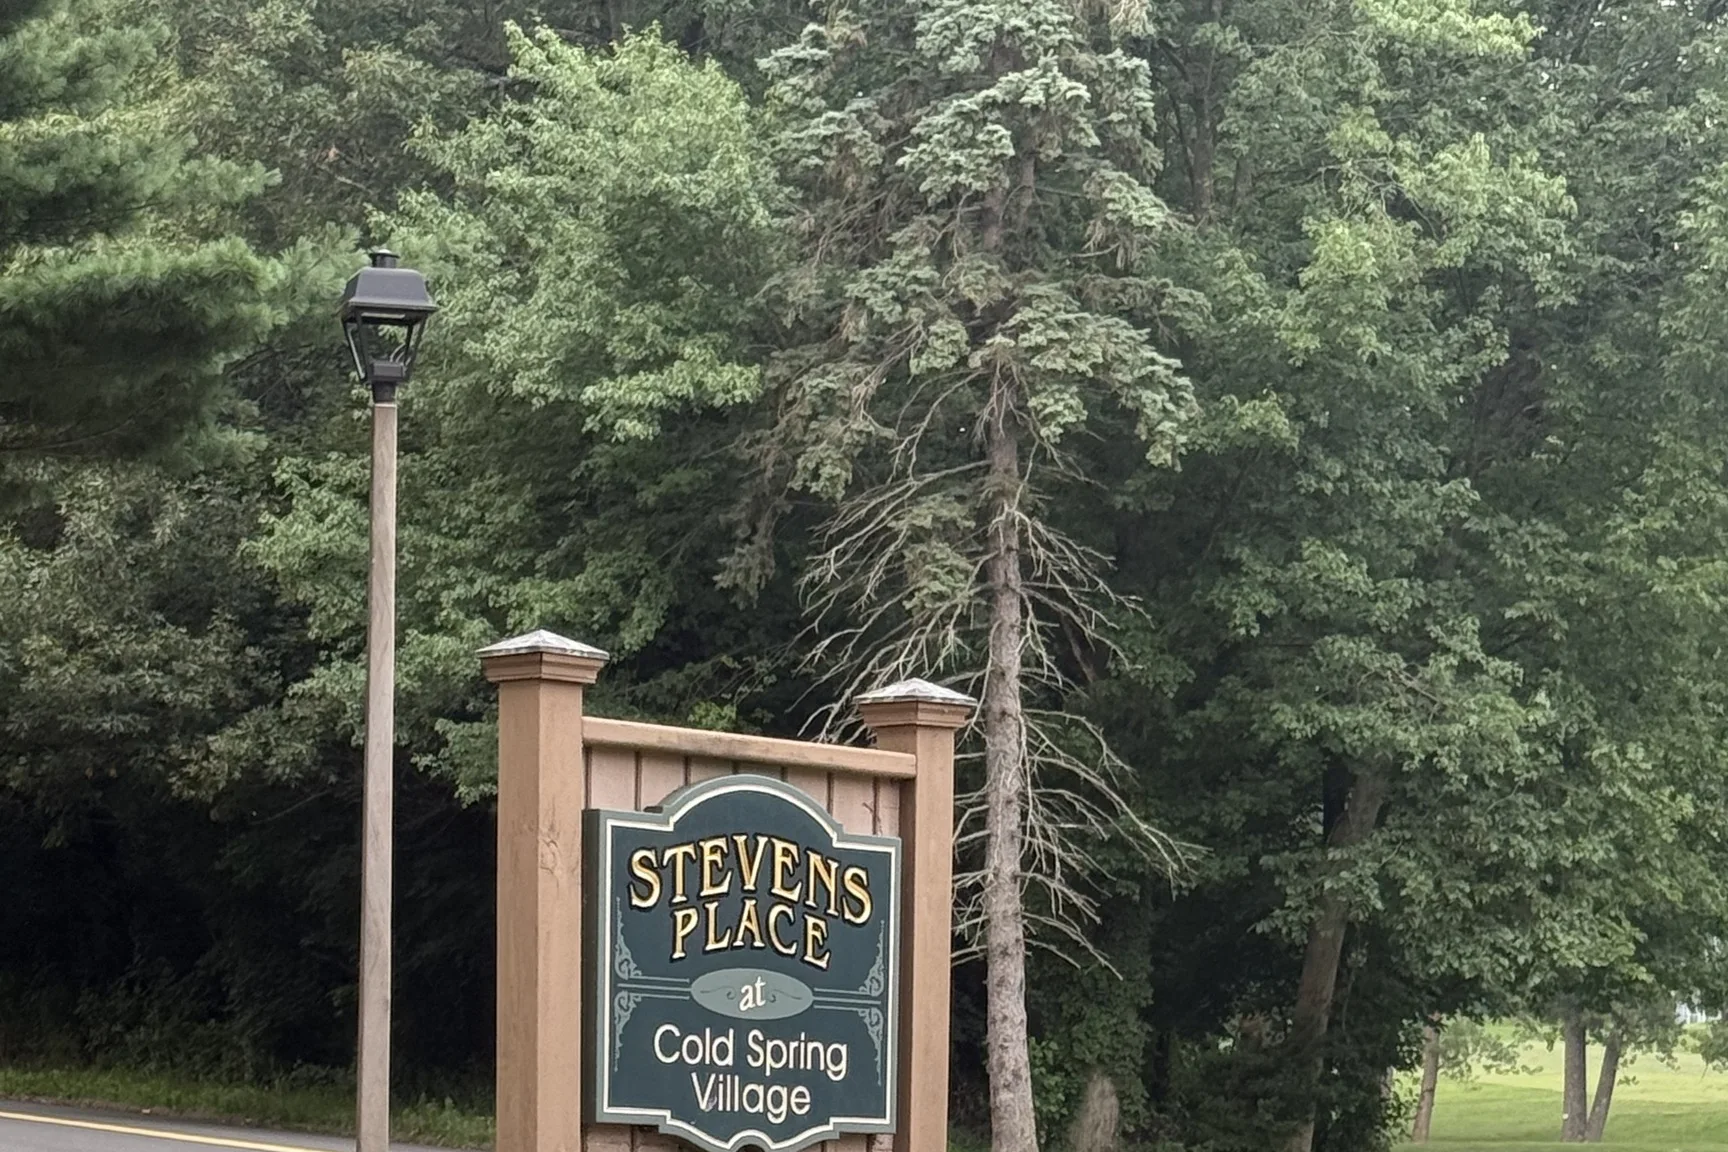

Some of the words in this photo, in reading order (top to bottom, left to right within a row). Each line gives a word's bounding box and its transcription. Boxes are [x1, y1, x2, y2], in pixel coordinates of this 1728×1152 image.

[629, 833, 873, 926] STEVENS
[671, 898, 831, 970] PLACE
[738, 975, 768, 1012] at
[653, 1023, 735, 1067] Cold
[747, 1028, 848, 1082] Spring
[690, 1071, 812, 1124] Village
